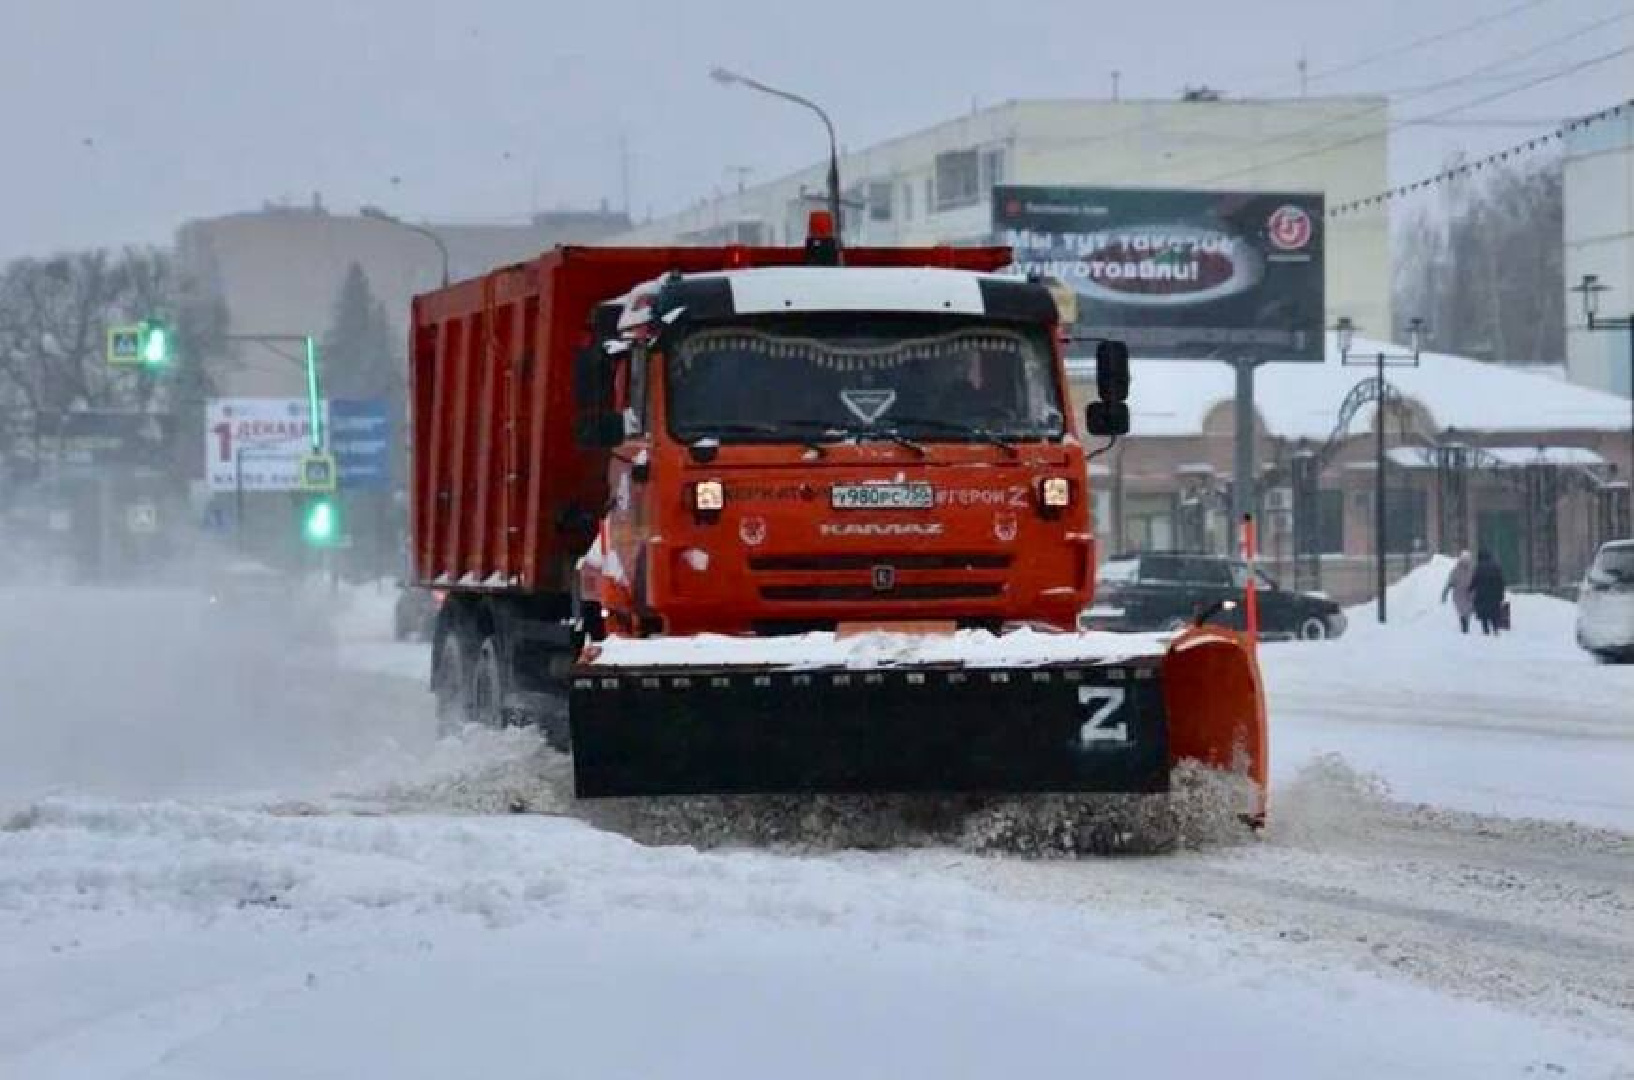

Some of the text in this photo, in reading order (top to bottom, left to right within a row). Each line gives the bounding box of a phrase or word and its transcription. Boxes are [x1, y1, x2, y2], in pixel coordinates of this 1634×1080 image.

[1063, 232, 1108, 256] тут
[210, 422, 232, 463] 1
[1077, 686, 1128, 743] Z
